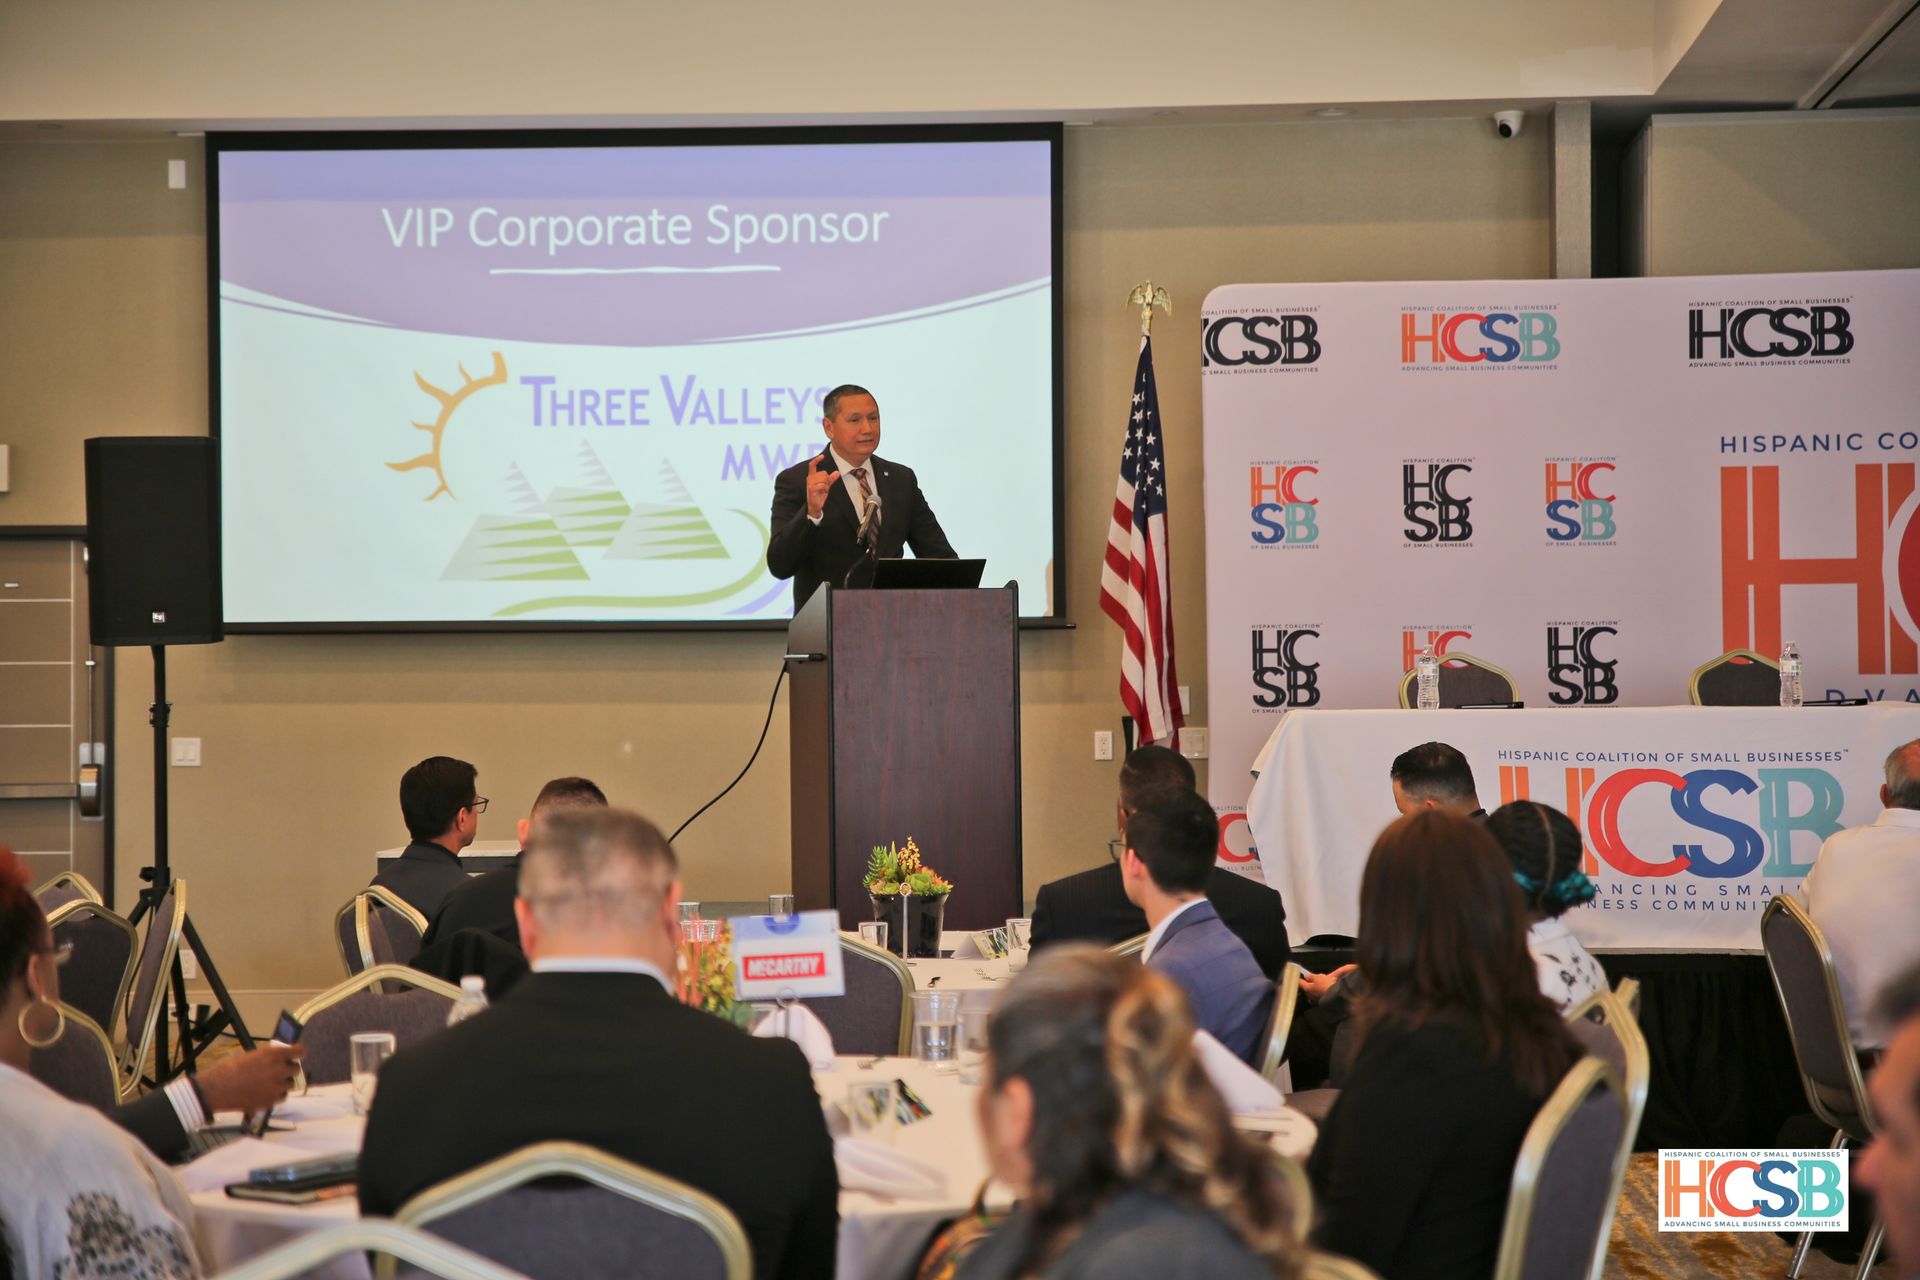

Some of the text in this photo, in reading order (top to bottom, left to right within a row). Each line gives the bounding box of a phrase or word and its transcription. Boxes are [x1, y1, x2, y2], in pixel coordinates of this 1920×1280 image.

[381, 204, 890, 256] VIP Corporate Sponsor
[1201, 315, 1321, 367] CSB
[1401, 312, 1561, 363] HCSB
[1689, 305, 1855, 360] HCSB
[520, 376, 651, 427] THREE
[1721, 433, 1863, 453] HISPANIC
[1251, 465, 1319, 507] HC
[1403, 464, 1472, 505] HC
[1545, 462, 1617, 504] HC
[1251, 502, 1319, 544] SB
[1404, 501, 1472, 542] SB
[1546, 500, 1617, 541] SB
[1252, 629, 1320, 671] HC
[1547, 626, 1618, 668] HC
[1252, 666, 1320, 708] SB
[1548, 664, 1619, 705] SB
[1498, 750, 1569, 762] HISPANIC
[1575, 751, 1658, 763] COALITION
[1665, 752, 1686, 762] OF
[1691, 751, 1741, 762] SMALL
[1652, 900, 1769, 911] COMMUNIT
[1719, 884, 1801, 896] SMAL
